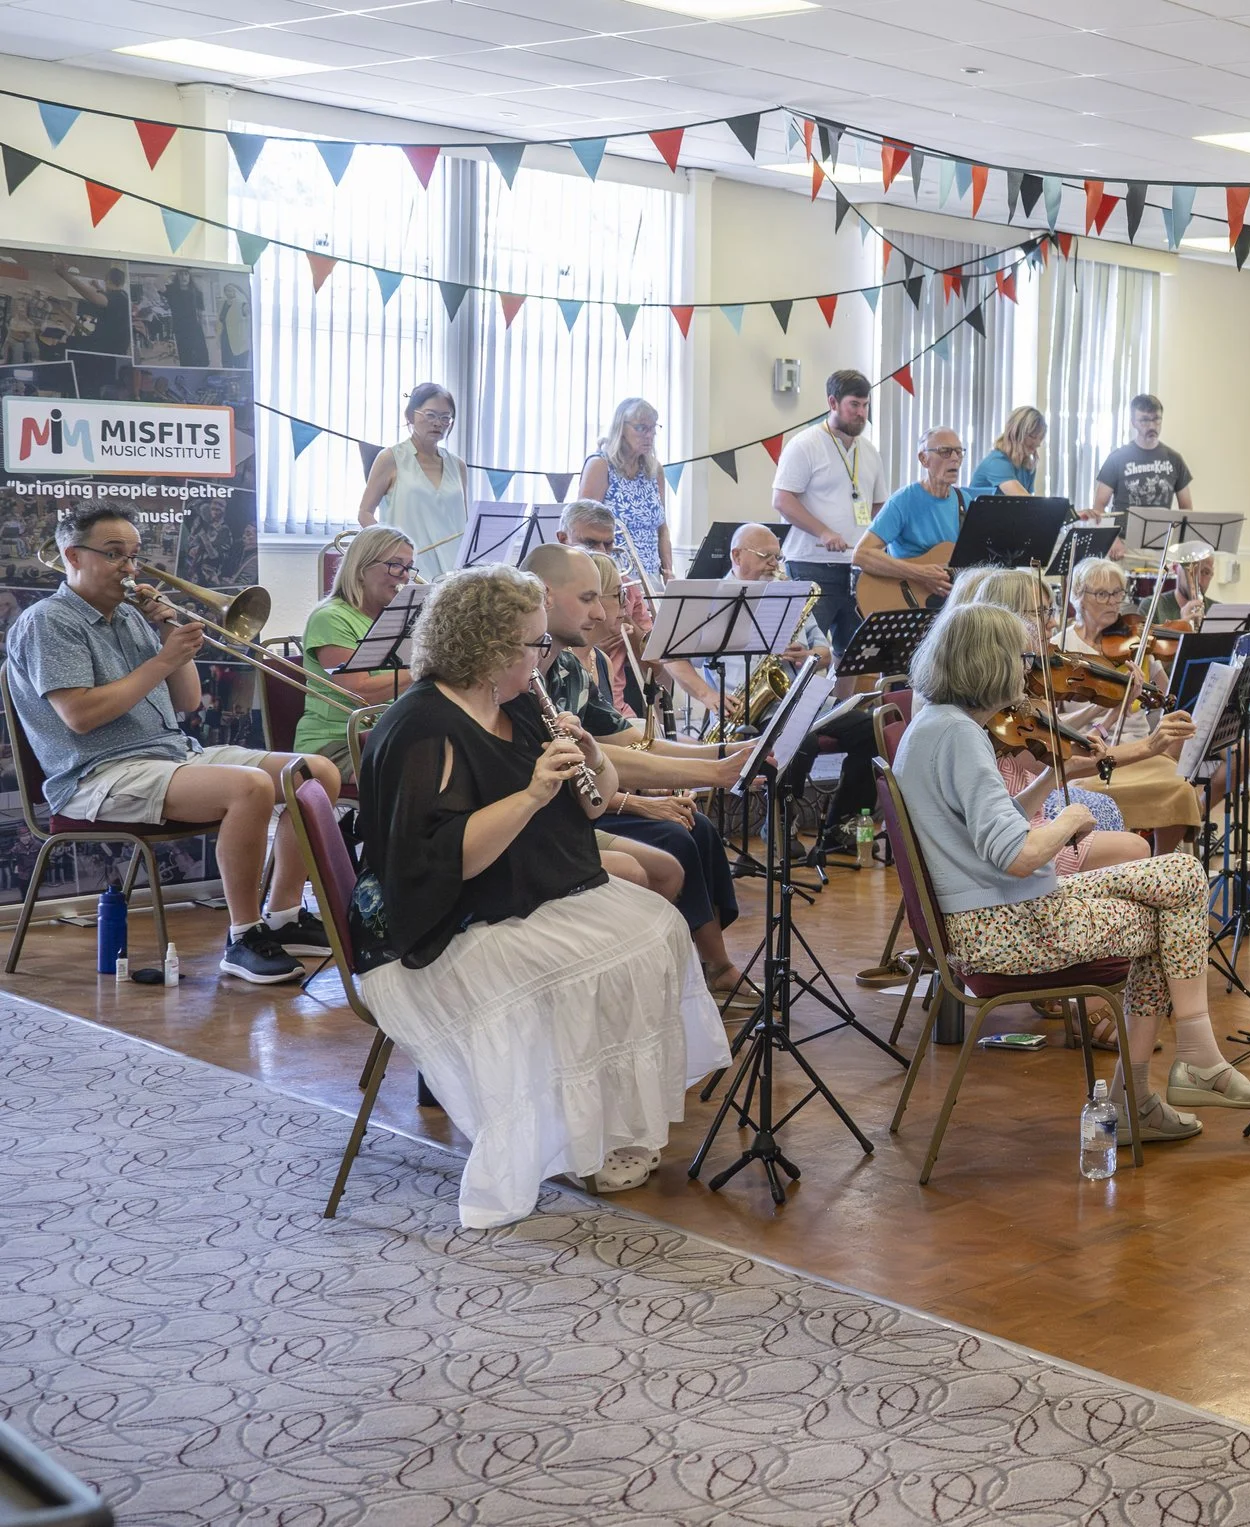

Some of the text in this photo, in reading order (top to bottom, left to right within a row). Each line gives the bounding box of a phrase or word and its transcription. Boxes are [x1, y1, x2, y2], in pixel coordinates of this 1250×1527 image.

[101, 419, 220, 446] MISFITS
[101, 444, 221, 459] MUSIC INSTITUTE
[6, 480, 234, 500] “bringing people together
